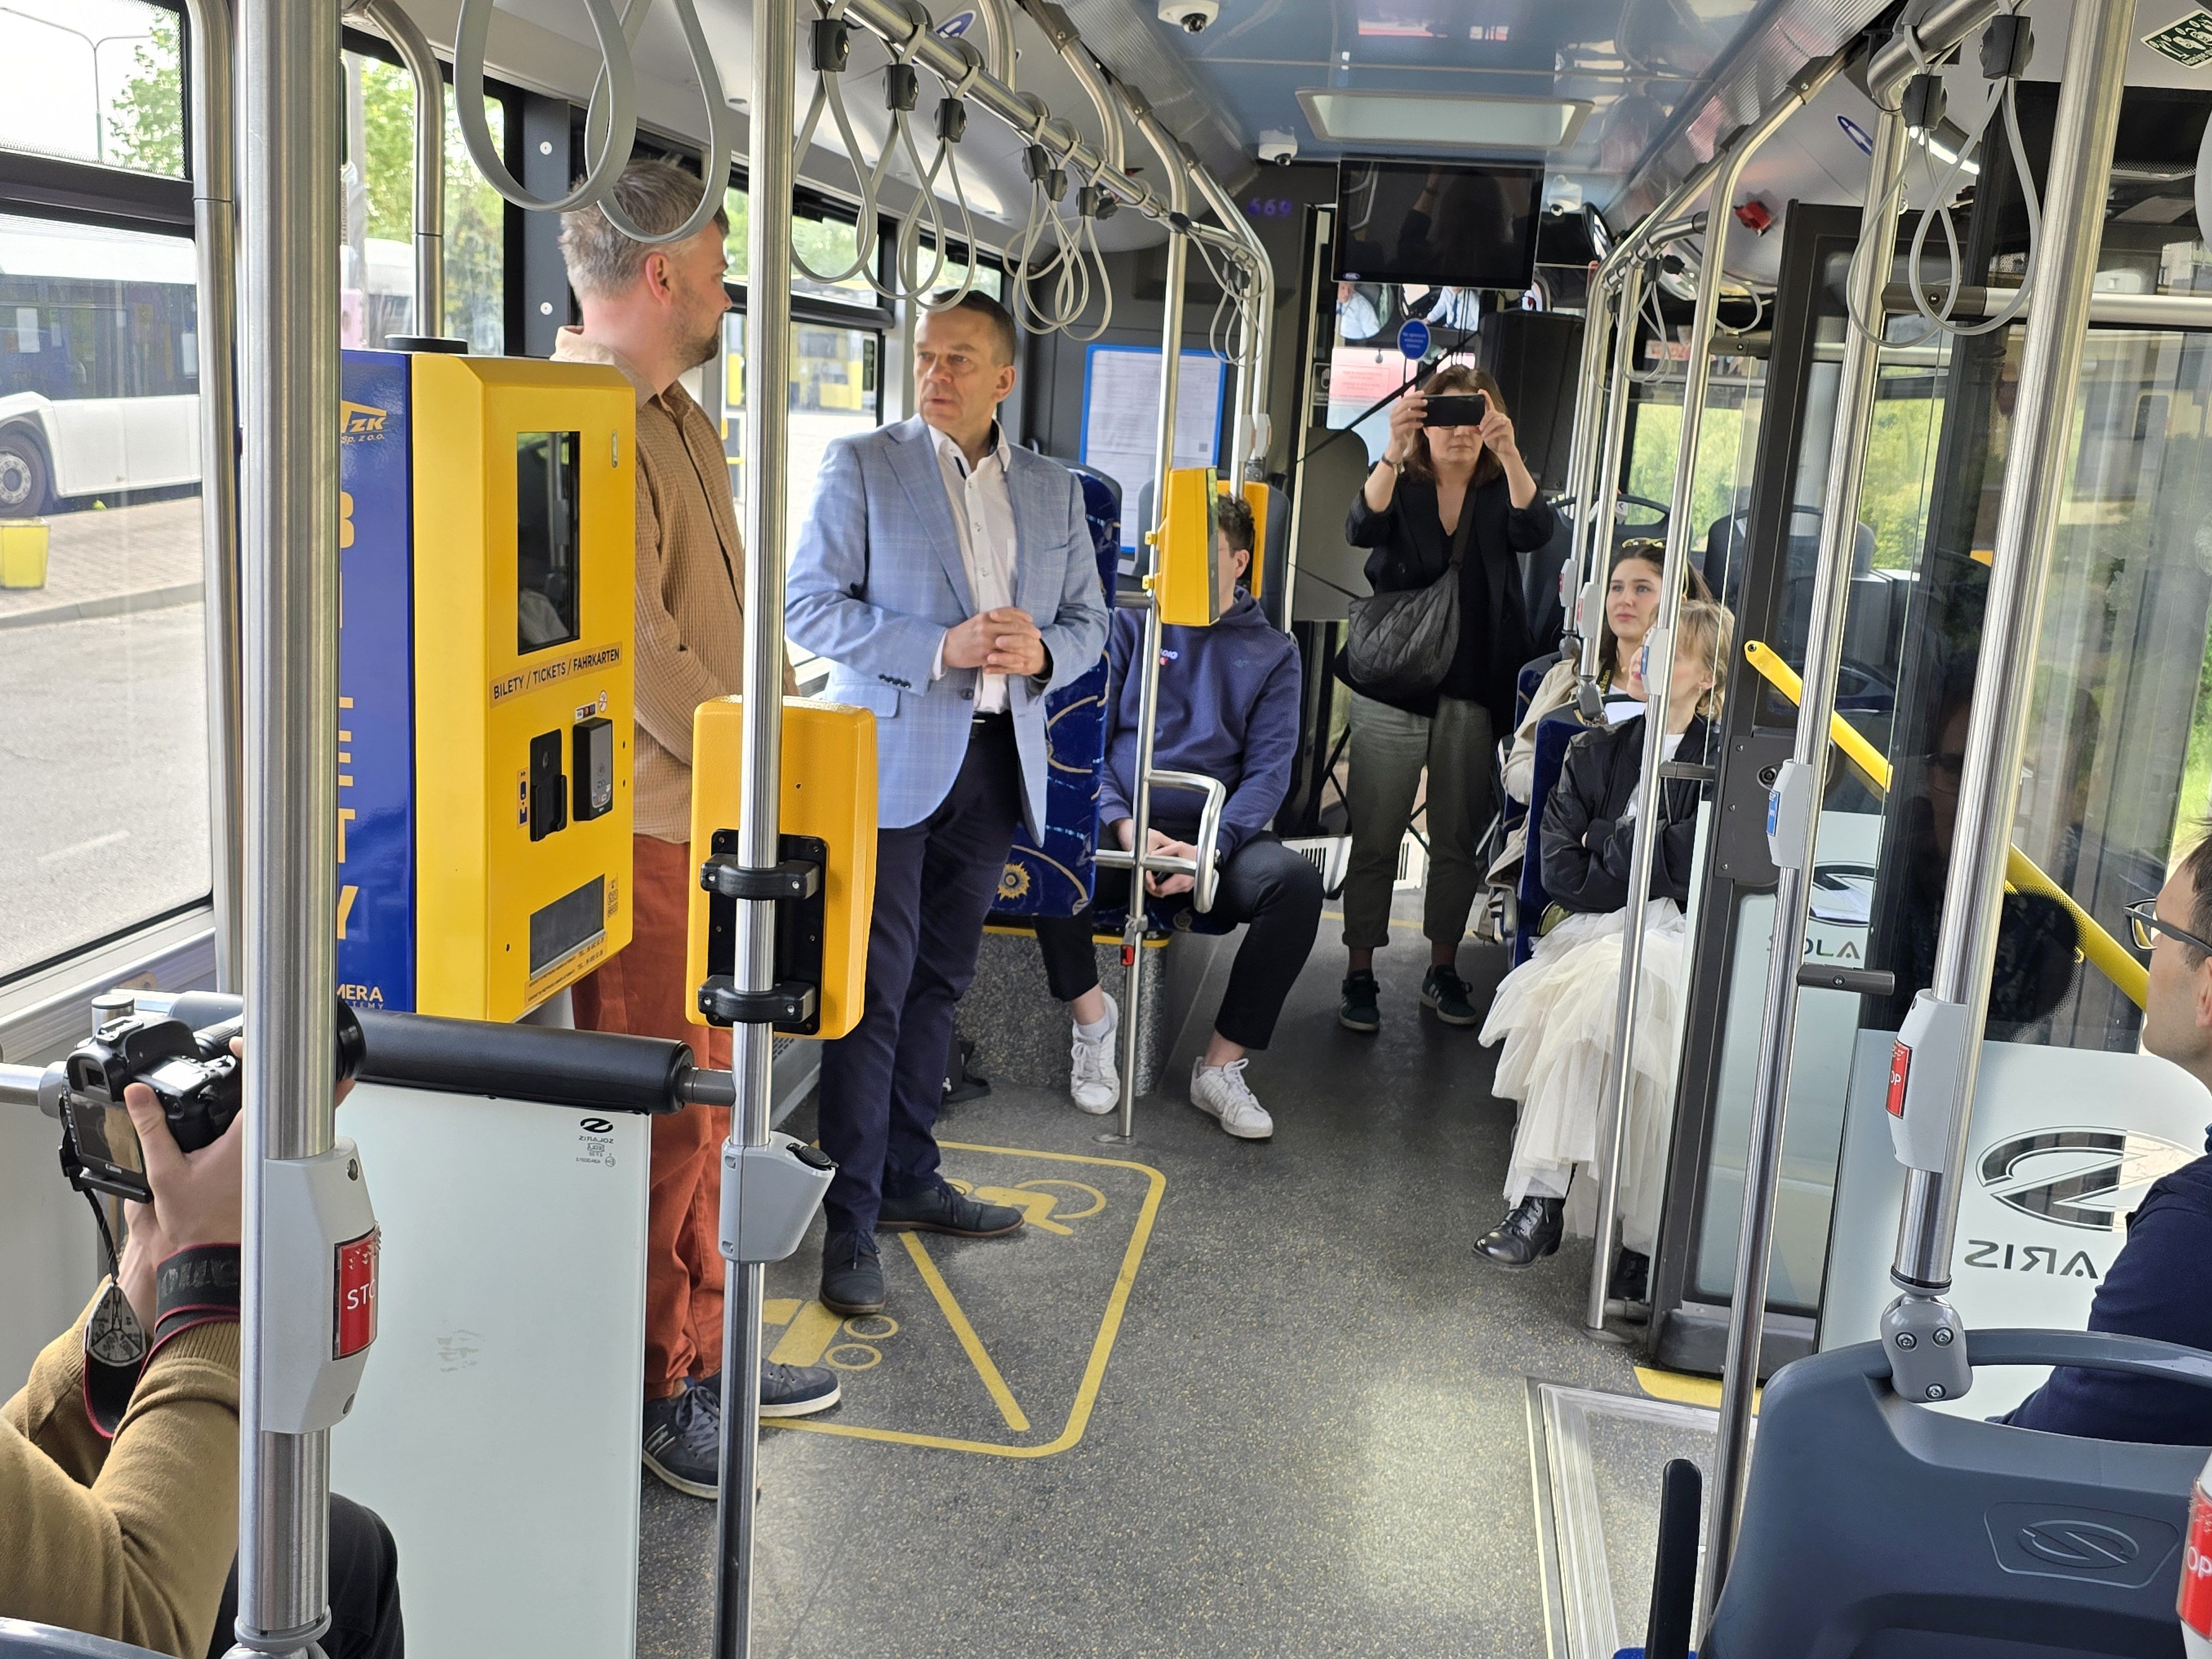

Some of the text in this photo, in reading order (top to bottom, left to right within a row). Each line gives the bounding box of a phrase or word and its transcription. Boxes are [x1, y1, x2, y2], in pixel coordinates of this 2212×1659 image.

[494, 675, 525, 700] BILETY
[533, 662, 566, 686] TICKETS
[573, 647, 620, 672] FAHRKARTEN
